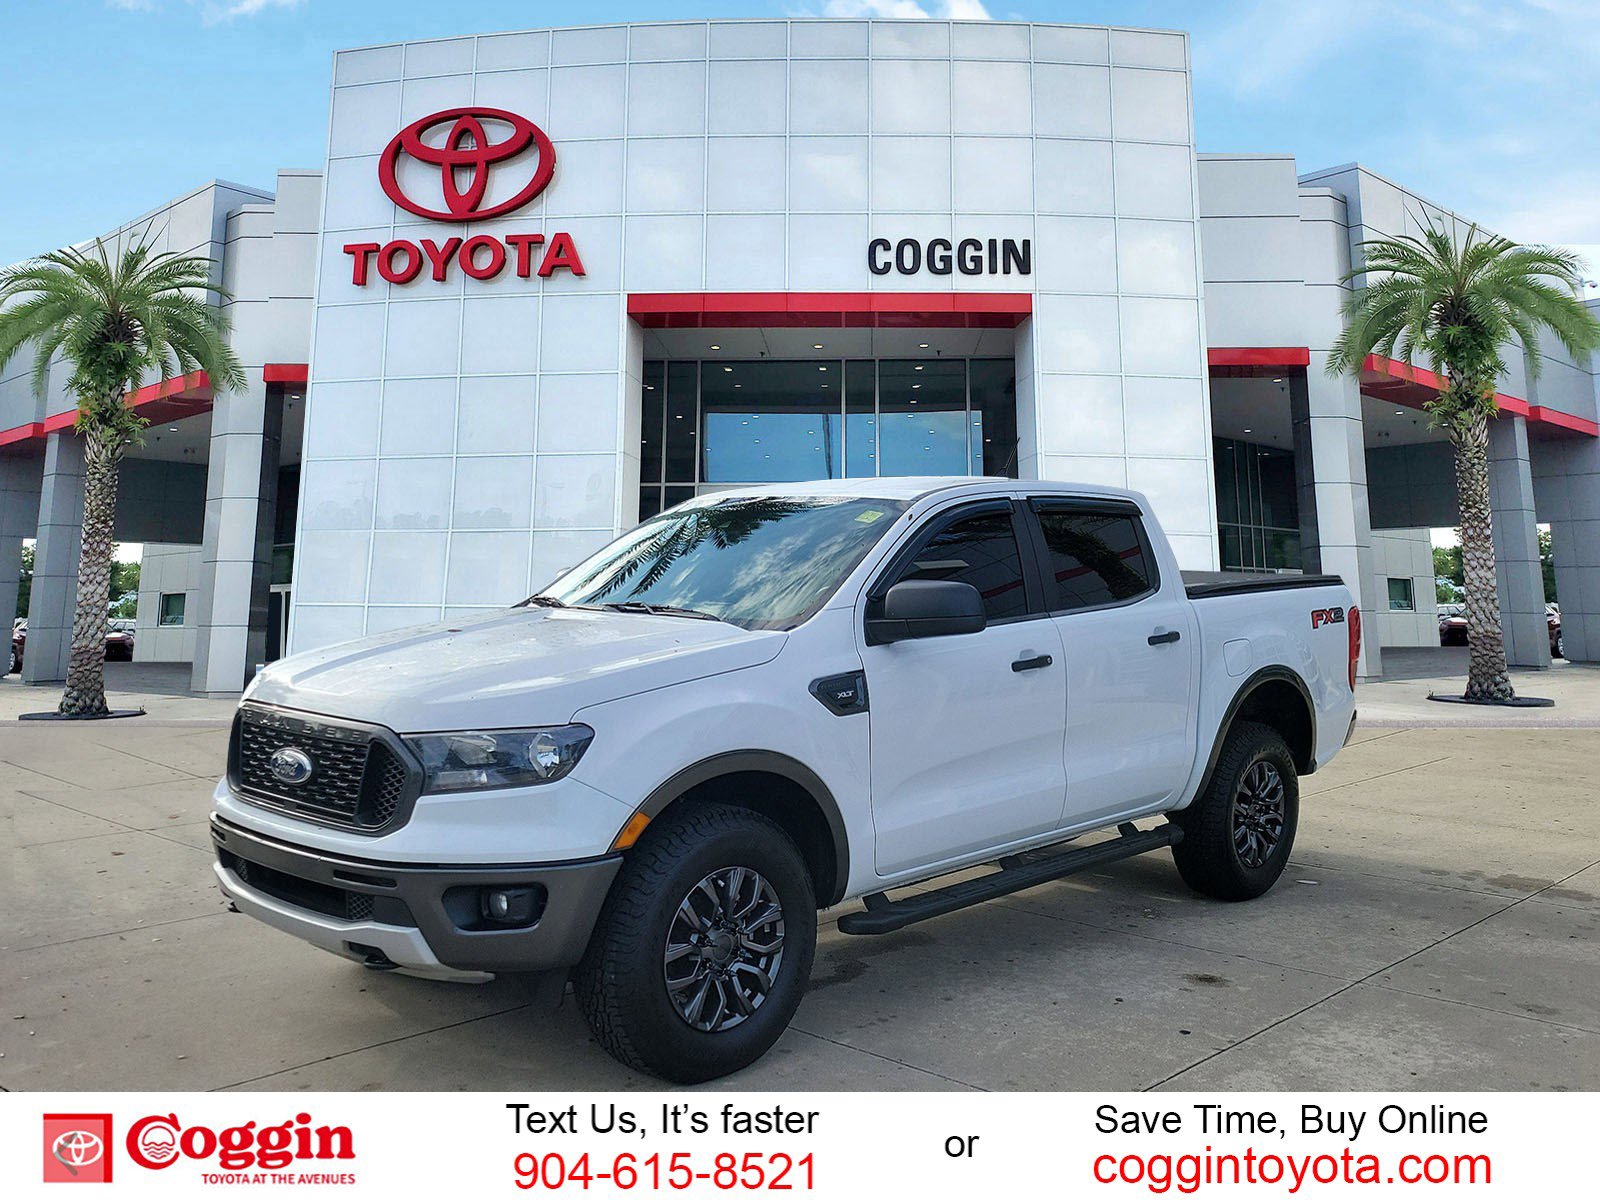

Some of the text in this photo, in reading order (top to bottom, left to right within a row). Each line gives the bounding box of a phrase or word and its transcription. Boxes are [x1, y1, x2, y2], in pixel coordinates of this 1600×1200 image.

[344, 233, 585, 284] TOYOTA
[868, 238, 1032, 276] COGGIN
[1311, 607, 1345, 629] FX2
[837, 690, 854, 699] XLT
